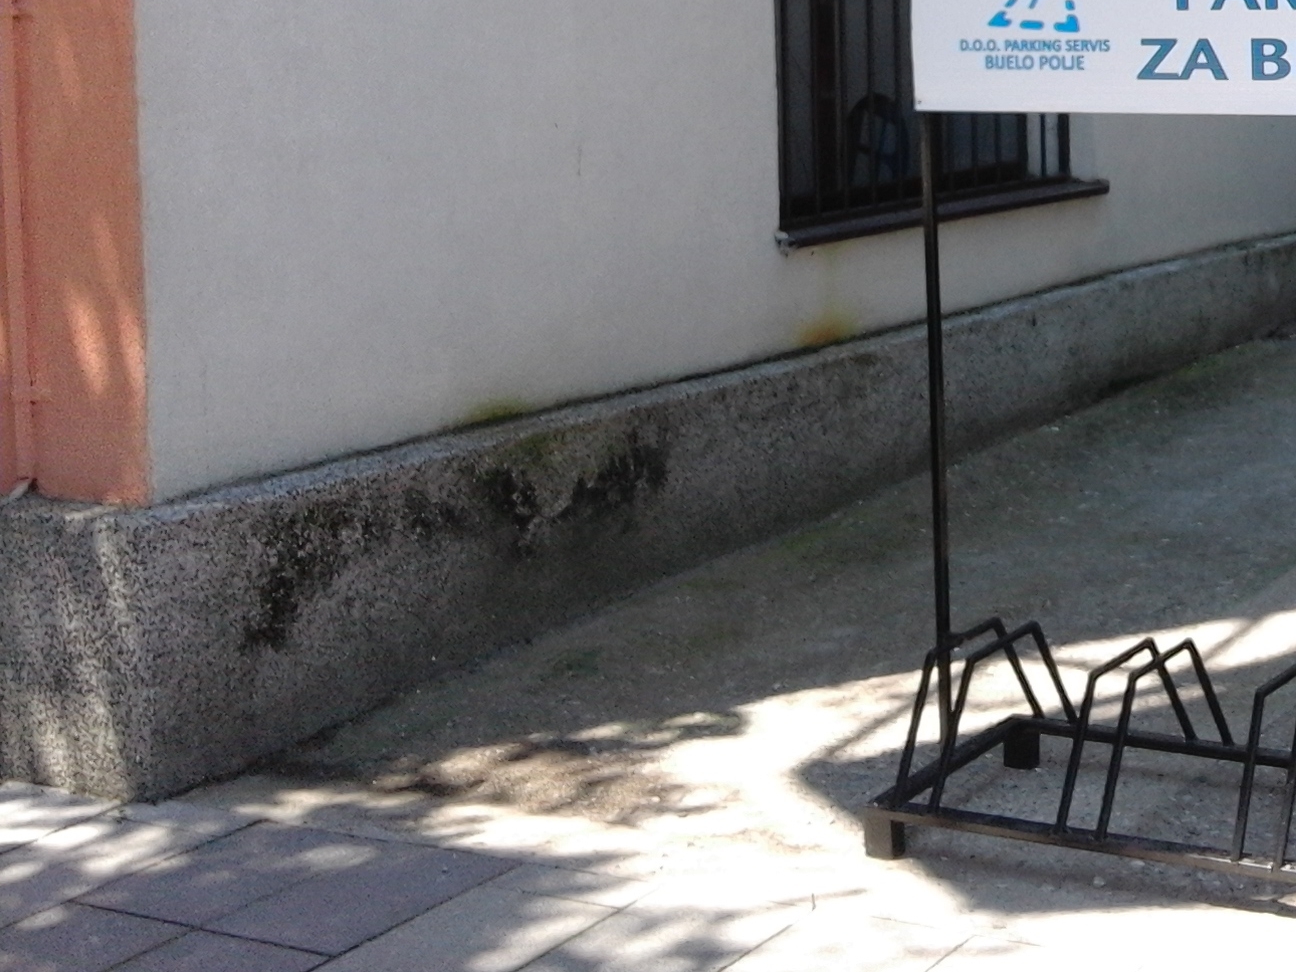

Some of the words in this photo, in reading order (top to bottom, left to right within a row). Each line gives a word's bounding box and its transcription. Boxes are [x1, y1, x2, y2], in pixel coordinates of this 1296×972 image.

[959, 38, 1001, 53] D.O.O.
[1004, 39, 1062, 53] PARKING
[1065, 39, 1111, 53] SERVIS
[1136, 37, 1230, 82] ZA
